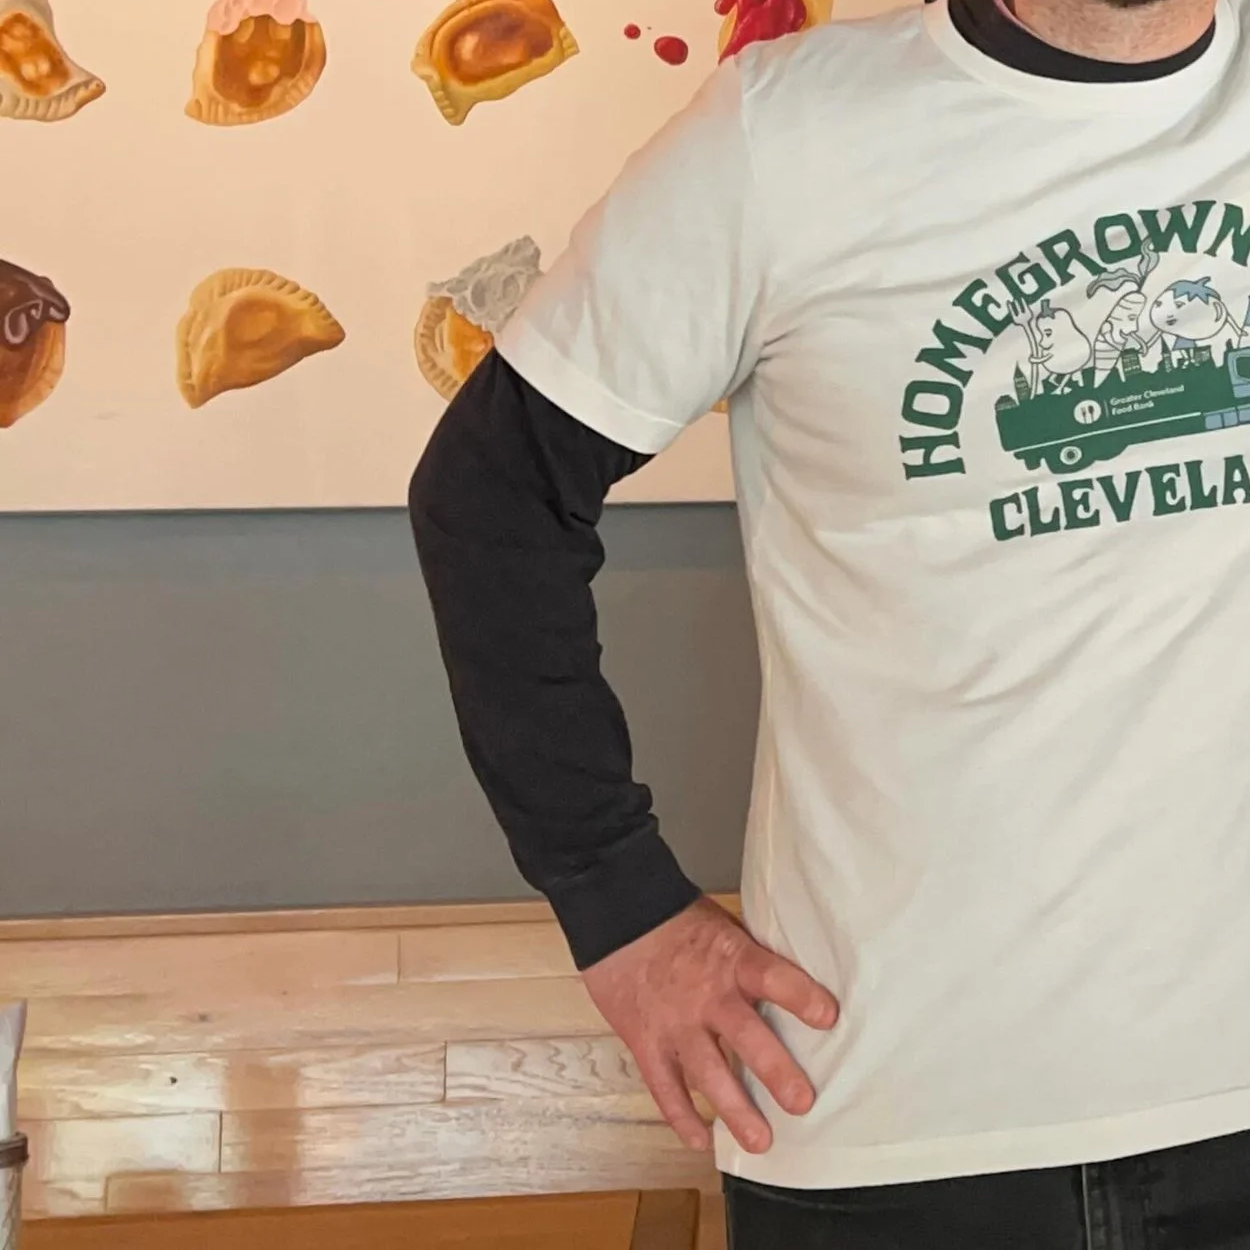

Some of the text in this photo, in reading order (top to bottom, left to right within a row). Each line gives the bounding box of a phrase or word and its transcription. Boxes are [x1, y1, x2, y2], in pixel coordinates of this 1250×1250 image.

[1110, 384, 1185, 406] Greater Cleveland
[1111, 400, 1155, 416] Food Bank
